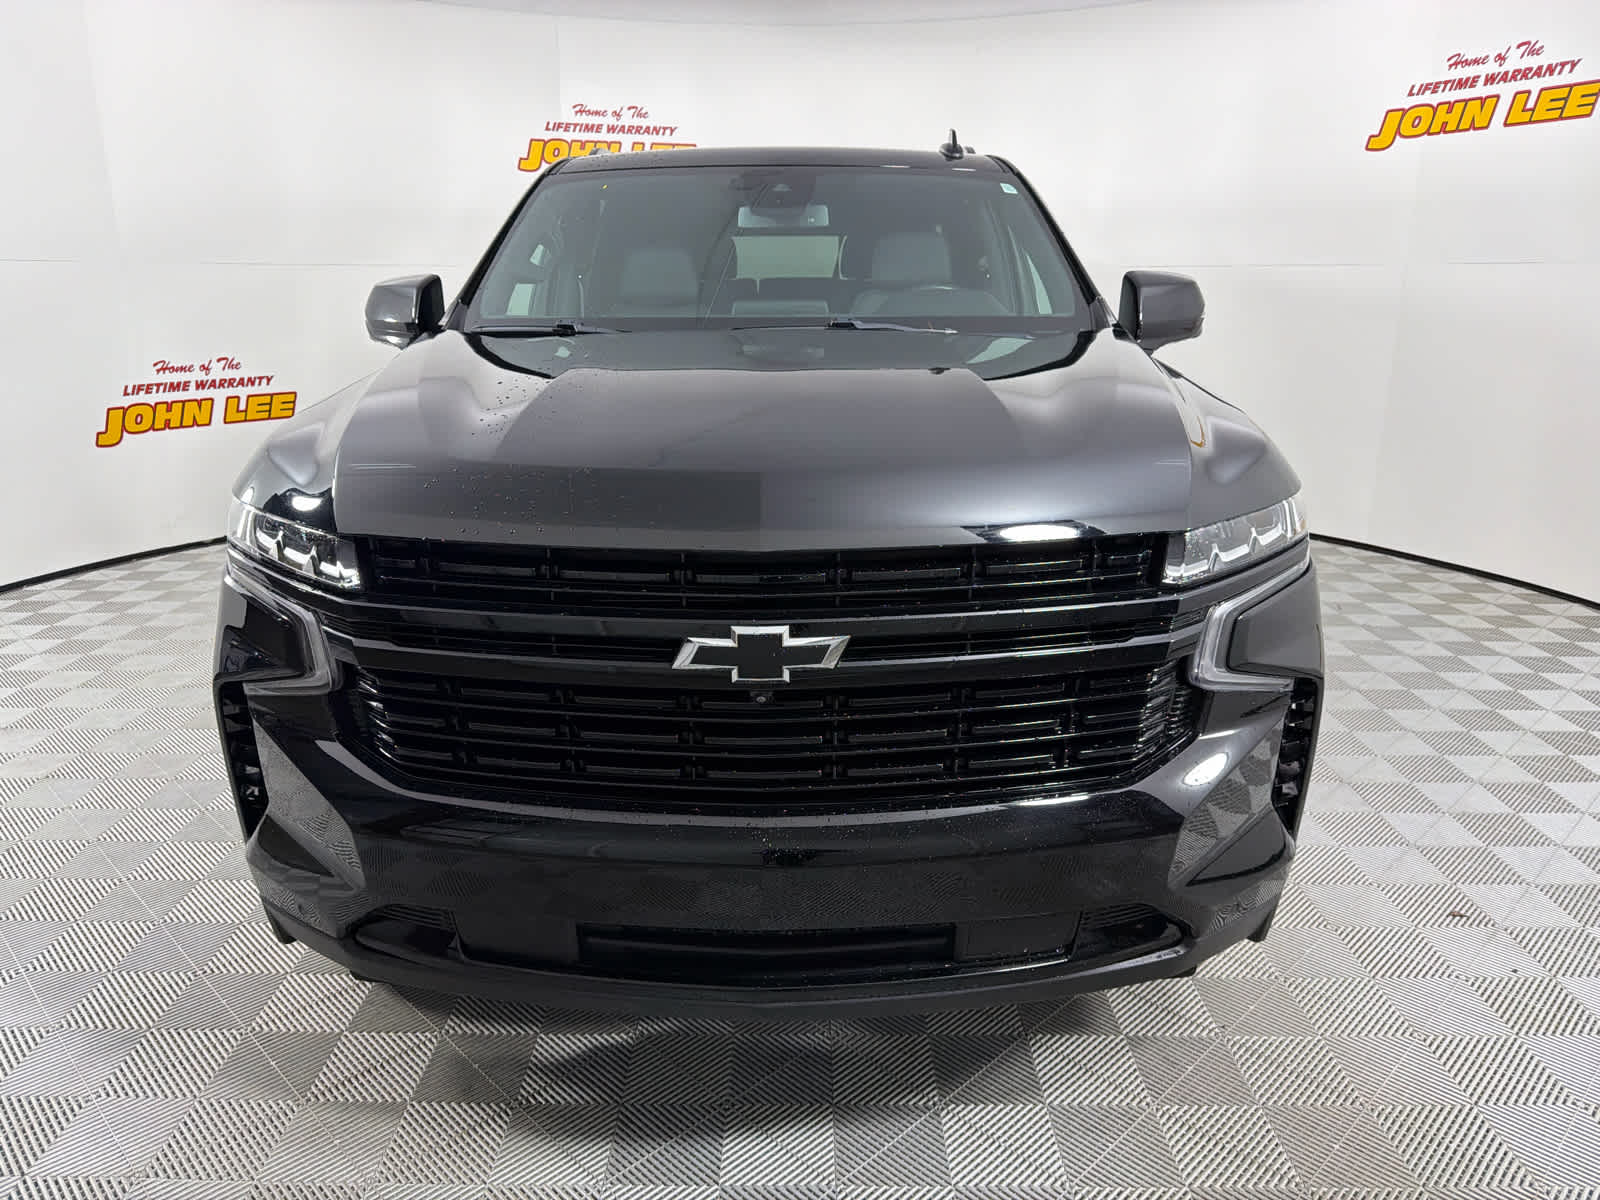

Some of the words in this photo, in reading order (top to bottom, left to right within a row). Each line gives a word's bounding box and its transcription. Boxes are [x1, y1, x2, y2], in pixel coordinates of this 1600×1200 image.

[1446, 53, 1489, 71] Home
[1494, 46, 1511, 67] of
[1516, 40, 1545, 59] The
[1407, 75, 1481, 97] LIFETIME
[1483, 58, 1583, 87] WARRANTY
[572, 104, 608, 118] Home
[611, 107, 624, 121] of
[627, 105, 649, 119] The
[1365, 94, 1501, 152] JOHN
[1503, 79, 1600, 127] LEE
[545, 121, 603, 134] LIFETIME
[606, 124, 678, 136] WARRANTY
[152, 360, 195, 375] Home
[199, 360, 213, 376] of
[216, 357, 241, 371] The
[123, 380, 190, 396] LIFETIME
[195, 375, 274, 391] WARRANTY
[95, 397, 214, 448] JOHN
[223, 391, 297, 424] LEE
